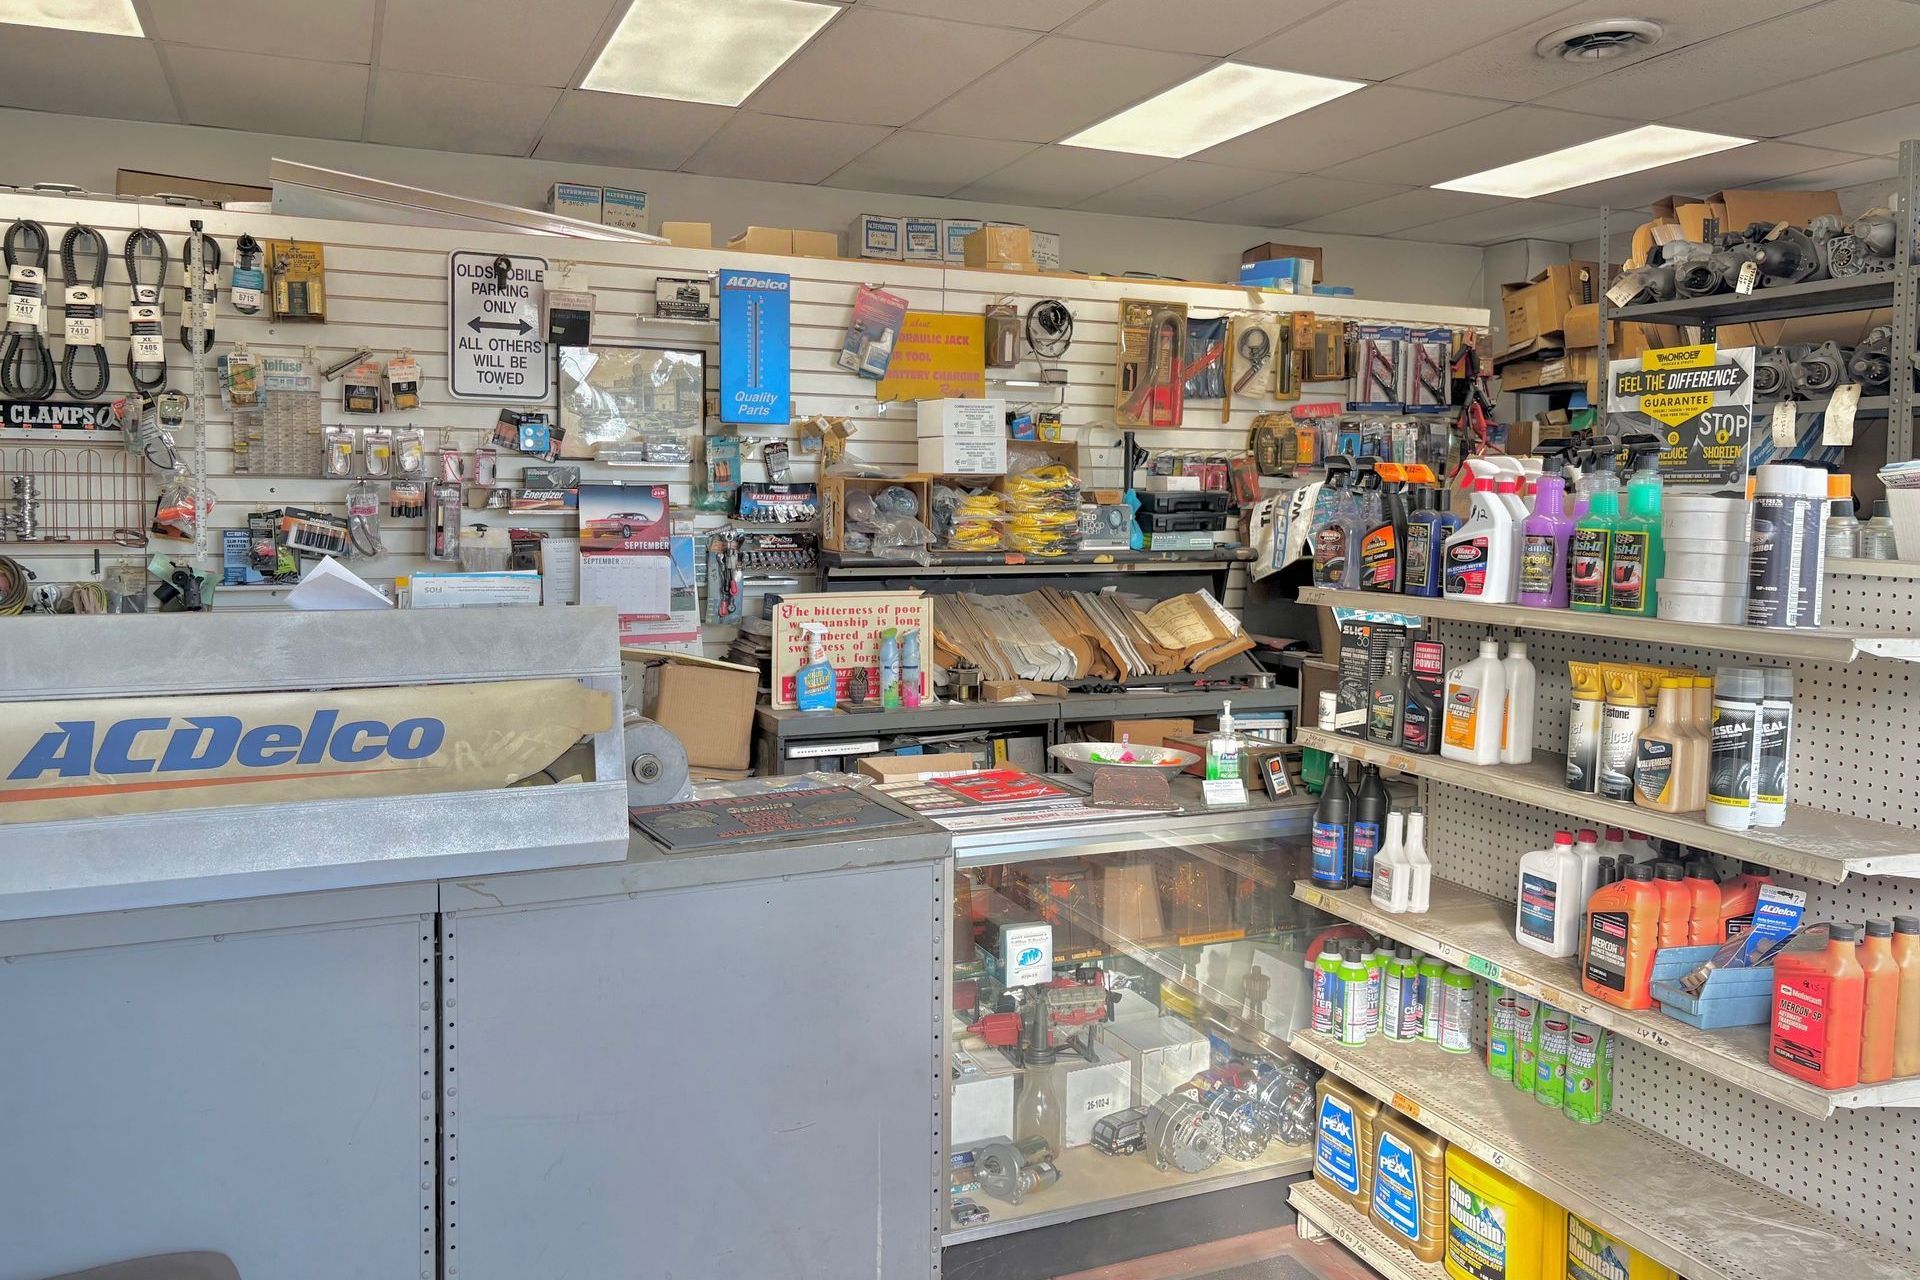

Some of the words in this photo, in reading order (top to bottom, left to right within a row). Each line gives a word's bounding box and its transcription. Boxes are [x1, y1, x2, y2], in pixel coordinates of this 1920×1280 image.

[867, 222, 897, 232] ALTERNATOR
[907, 225, 937, 233] ALTERNATOR
[457, 264, 544, 283] OLDSOBILE
[726, 275, 788, 291] ACDelco
[15, 305, 34, 313] 7417
[483, 299, 517, 314] ONLY
[459, 337, 483, 350] ALL
[489, 338, 542, 354] OTHERS
[944, 335, 970, 345] JACK
[474, 355, 505, 368] WILL
[510, 356, 528, 369] BE
[905, 352, 932, 362] TOOL
[1659, 351, 1698, 362] MONROE
[477, 370, 525, 385] TOWED
[933, 371, 981, 380] CHARGER
[1618, 376, 1643, 394] FEEL
[1645, 374, 1665, 391] THE
[1667, 368, 1740, 390] DIFFERENCE
[735, 391, 779, 405] Quality
[1644, 395, 1709, 408] GUARANTEE
[11, 405, 95, 425] CLAMPS
[737, 404, 771, 417] Parts
[1699, 412, 1748, 438] STOP
[1703, 445, 1741, 460] SHORTEN
[523, 489, 564, 500] Energizer
[624, 541, 670, 550] SEPTEMBER
[782, 604, 810, 618] The
[814, 605, 873, 616] bitterness
[878, 605, 890, 614] of
[895, 606, 922, 616] poor
[877, 617, 887, 627] is
[895, 616, 921, 627] long
[853, 641, 864, 651] of
[836, 653, 846, 664] is
[1415, 659, 1440, 669] POWER
[7, 709, 446, 781] ACDelco
[1760, 905, 1798, 917] ACDelco
[1592, 936, 1617, 953] MERCON
[1619, 945, 1625, 956] V
[1792, 989, 1822, 1006] Motorcraft
[1780, 1000, 1809, 1017] MERCON
[1812, 1011, 1822, 1021] SP
[1322, 1115, 1352, 1141] PEAK
[1380, 1155, 1412, 1184] PEAK
[1450, 1179, 1472, 1210] Blue
[1450, 1197, 1503, 1245] Mountain
[1569, 1214, 1592, 1247] Blue
[1569, 1233, 1625, 1280] Mountain
